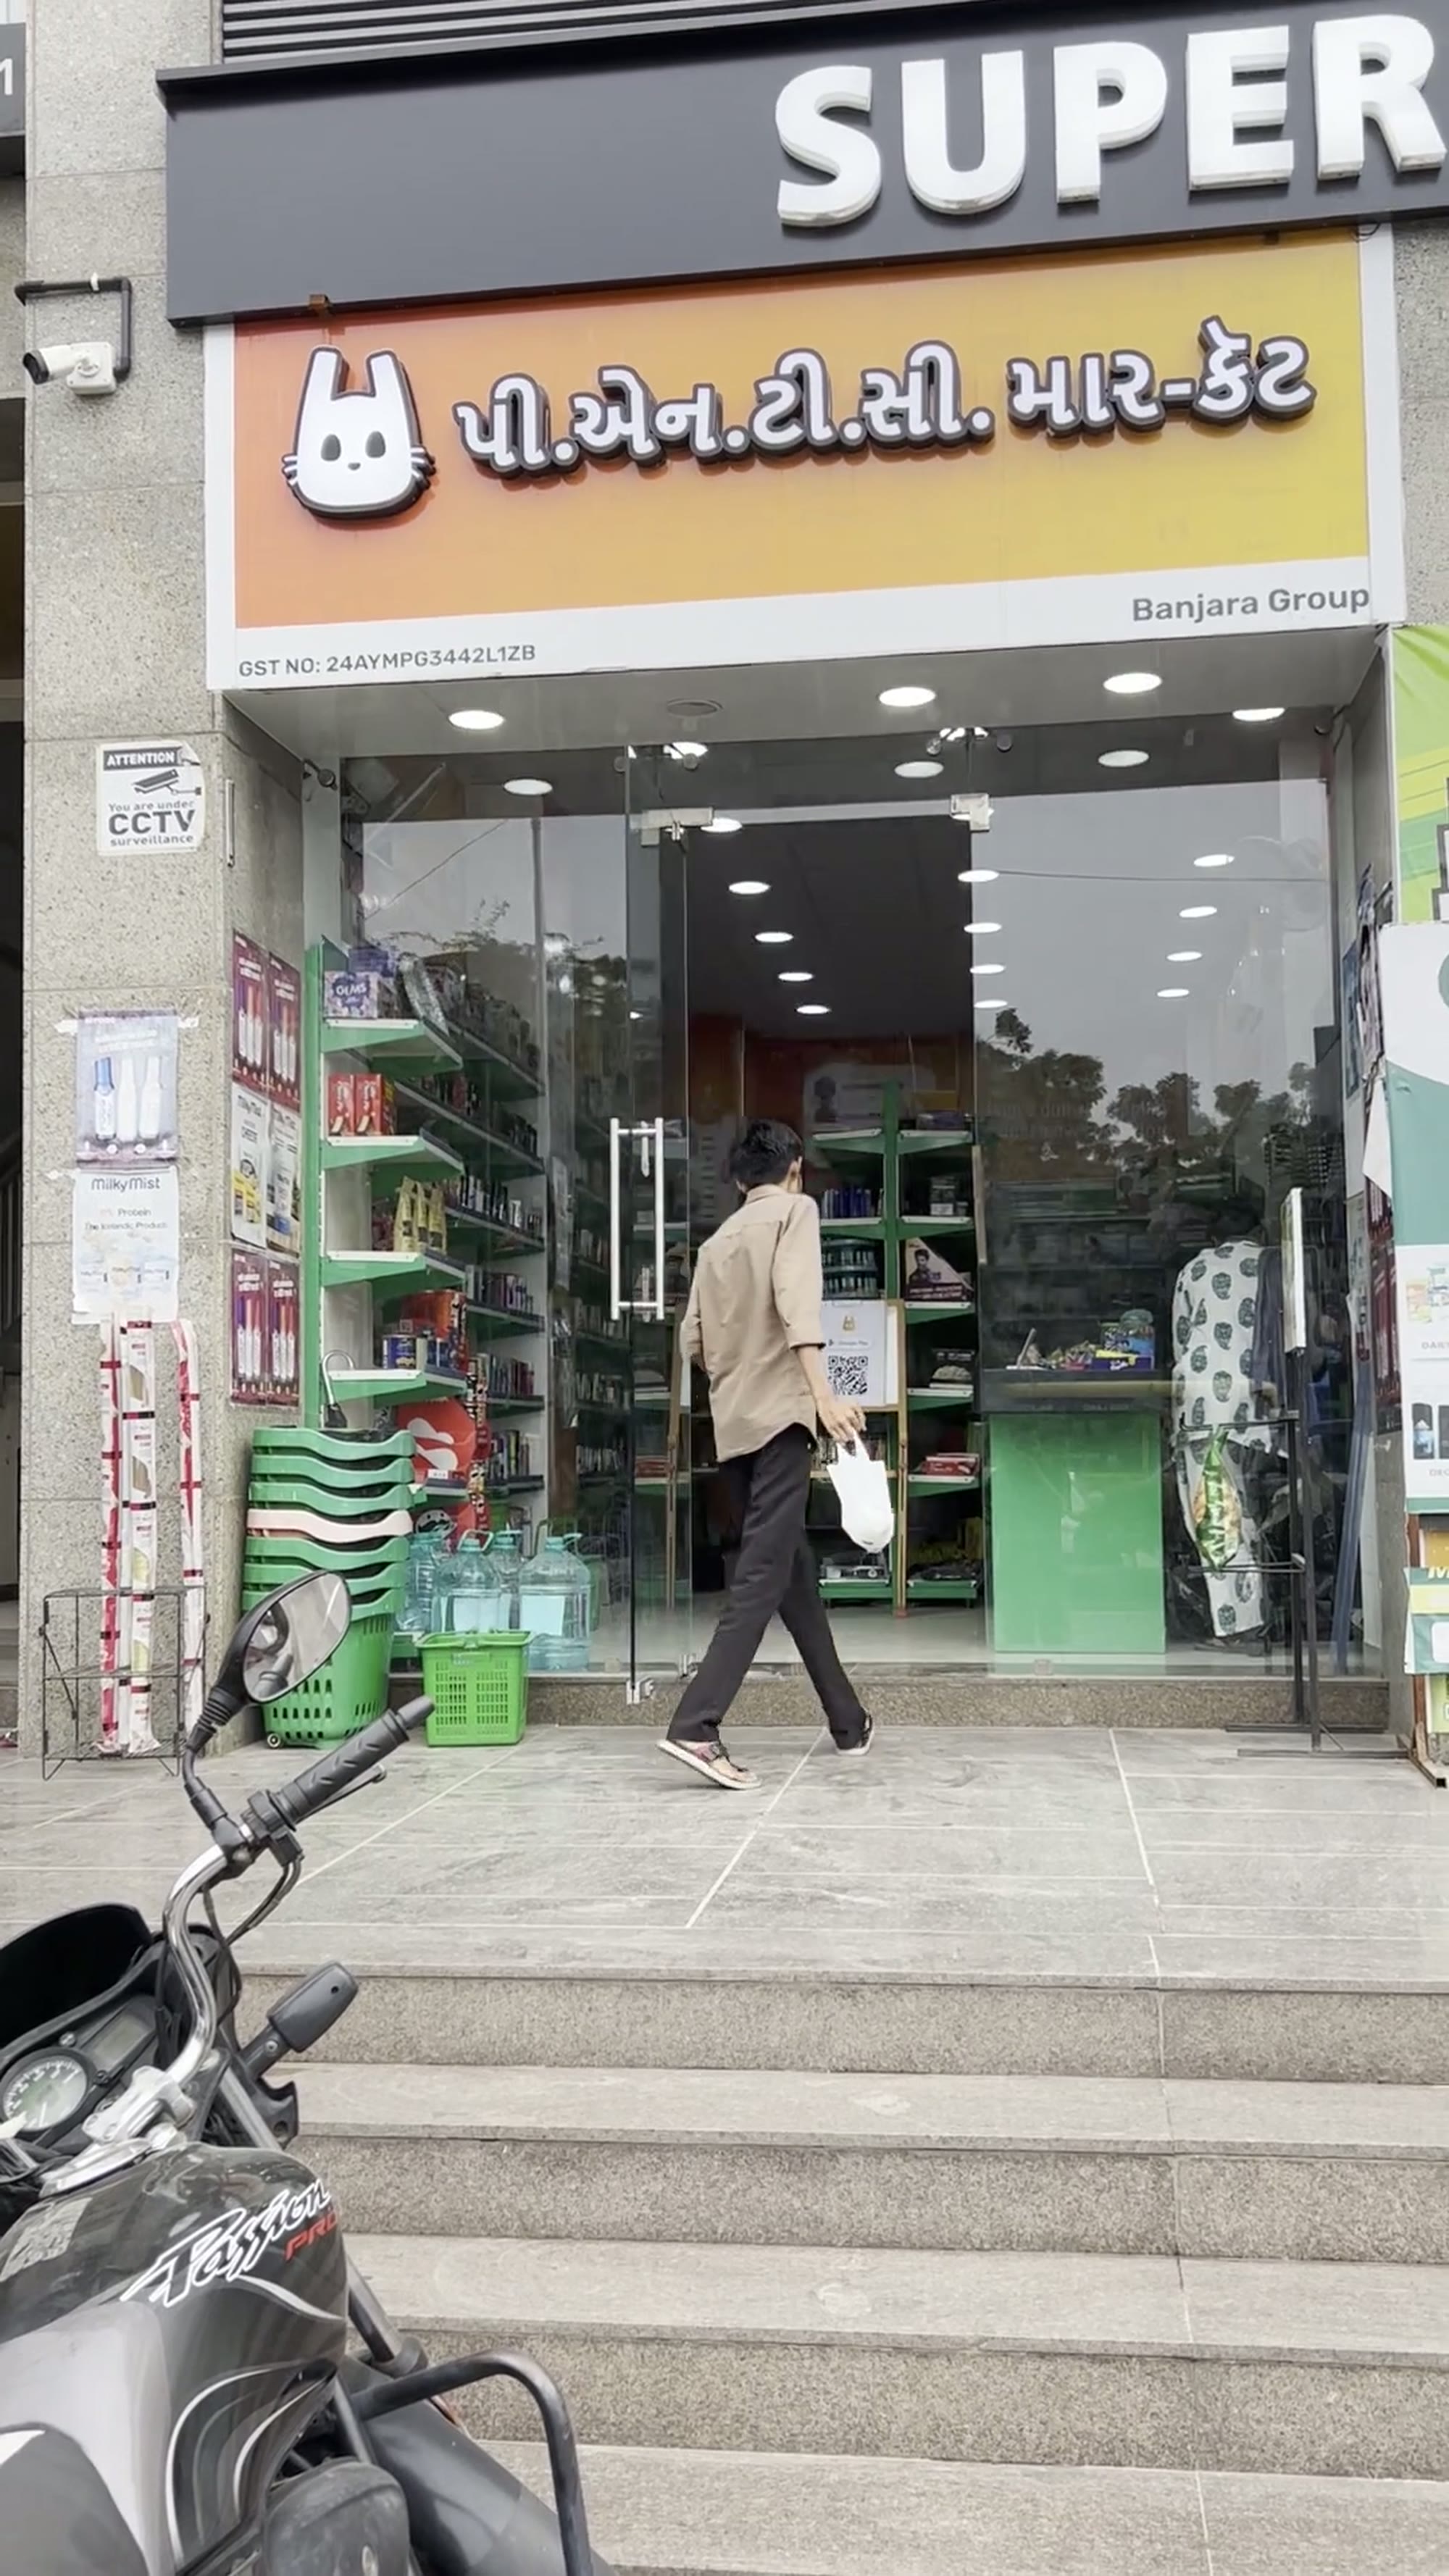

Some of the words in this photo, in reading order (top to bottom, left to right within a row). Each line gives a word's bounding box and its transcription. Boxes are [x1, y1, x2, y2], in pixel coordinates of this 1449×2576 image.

[774, 14, 1447, 227] SUPER
[1132, 593, 1258, 623] Banjara
[1268, 587, 1370, 616] Group
[238, 659, 280, 677] GST
[285, 657, 321, 674] NO:
[326, 645, 536, 673] 24AYMPG3442L1ZB
[107, 751, 175, 766] ATTENTION
[108, 803, 130, 812] You
[133, 802, 154, 811] are
[157, 800, 195, 809] under
[108, 809, 196, 835] CCTV
[110, 835, 194, 847] surveillance
[120, 2178, 333, 2309] Passion
